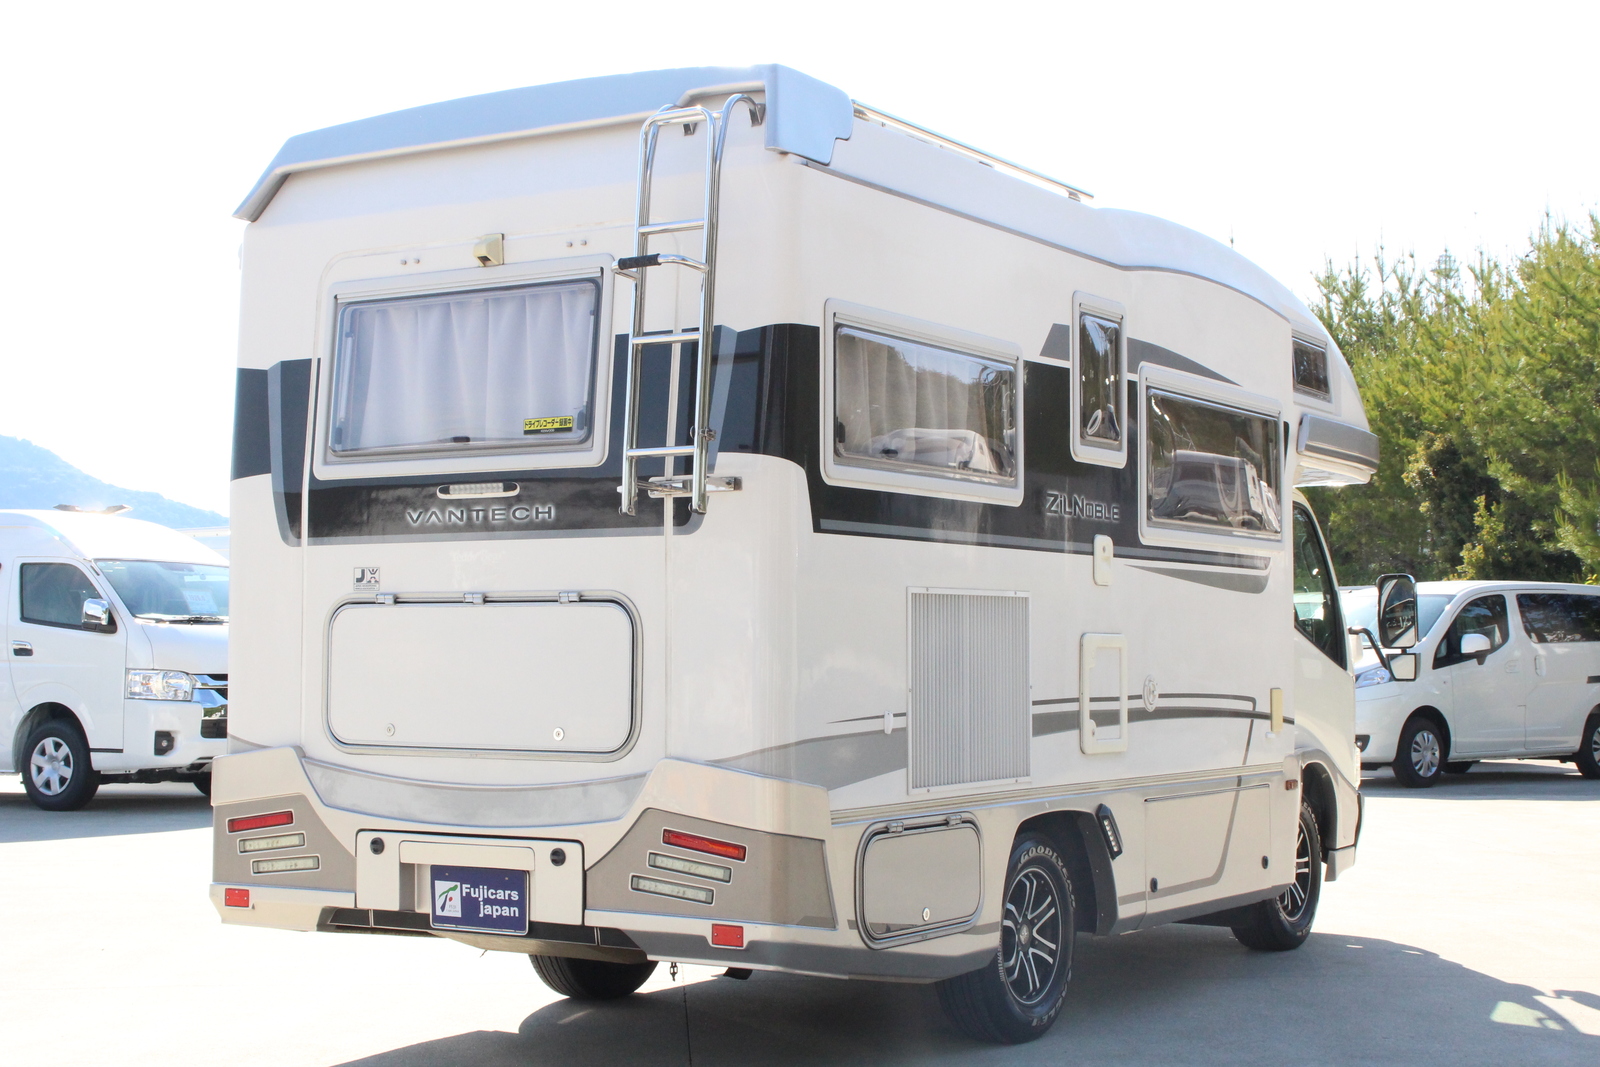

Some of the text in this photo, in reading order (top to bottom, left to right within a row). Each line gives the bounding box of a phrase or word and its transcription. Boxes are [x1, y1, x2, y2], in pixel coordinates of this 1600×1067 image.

[406, 506, 552, 524] VANTECH
[1020, 845, 1076, 908] GOODYEAR
[462, 884, 519, 901] Fujicars
[479, 902, 519, 918] japan
